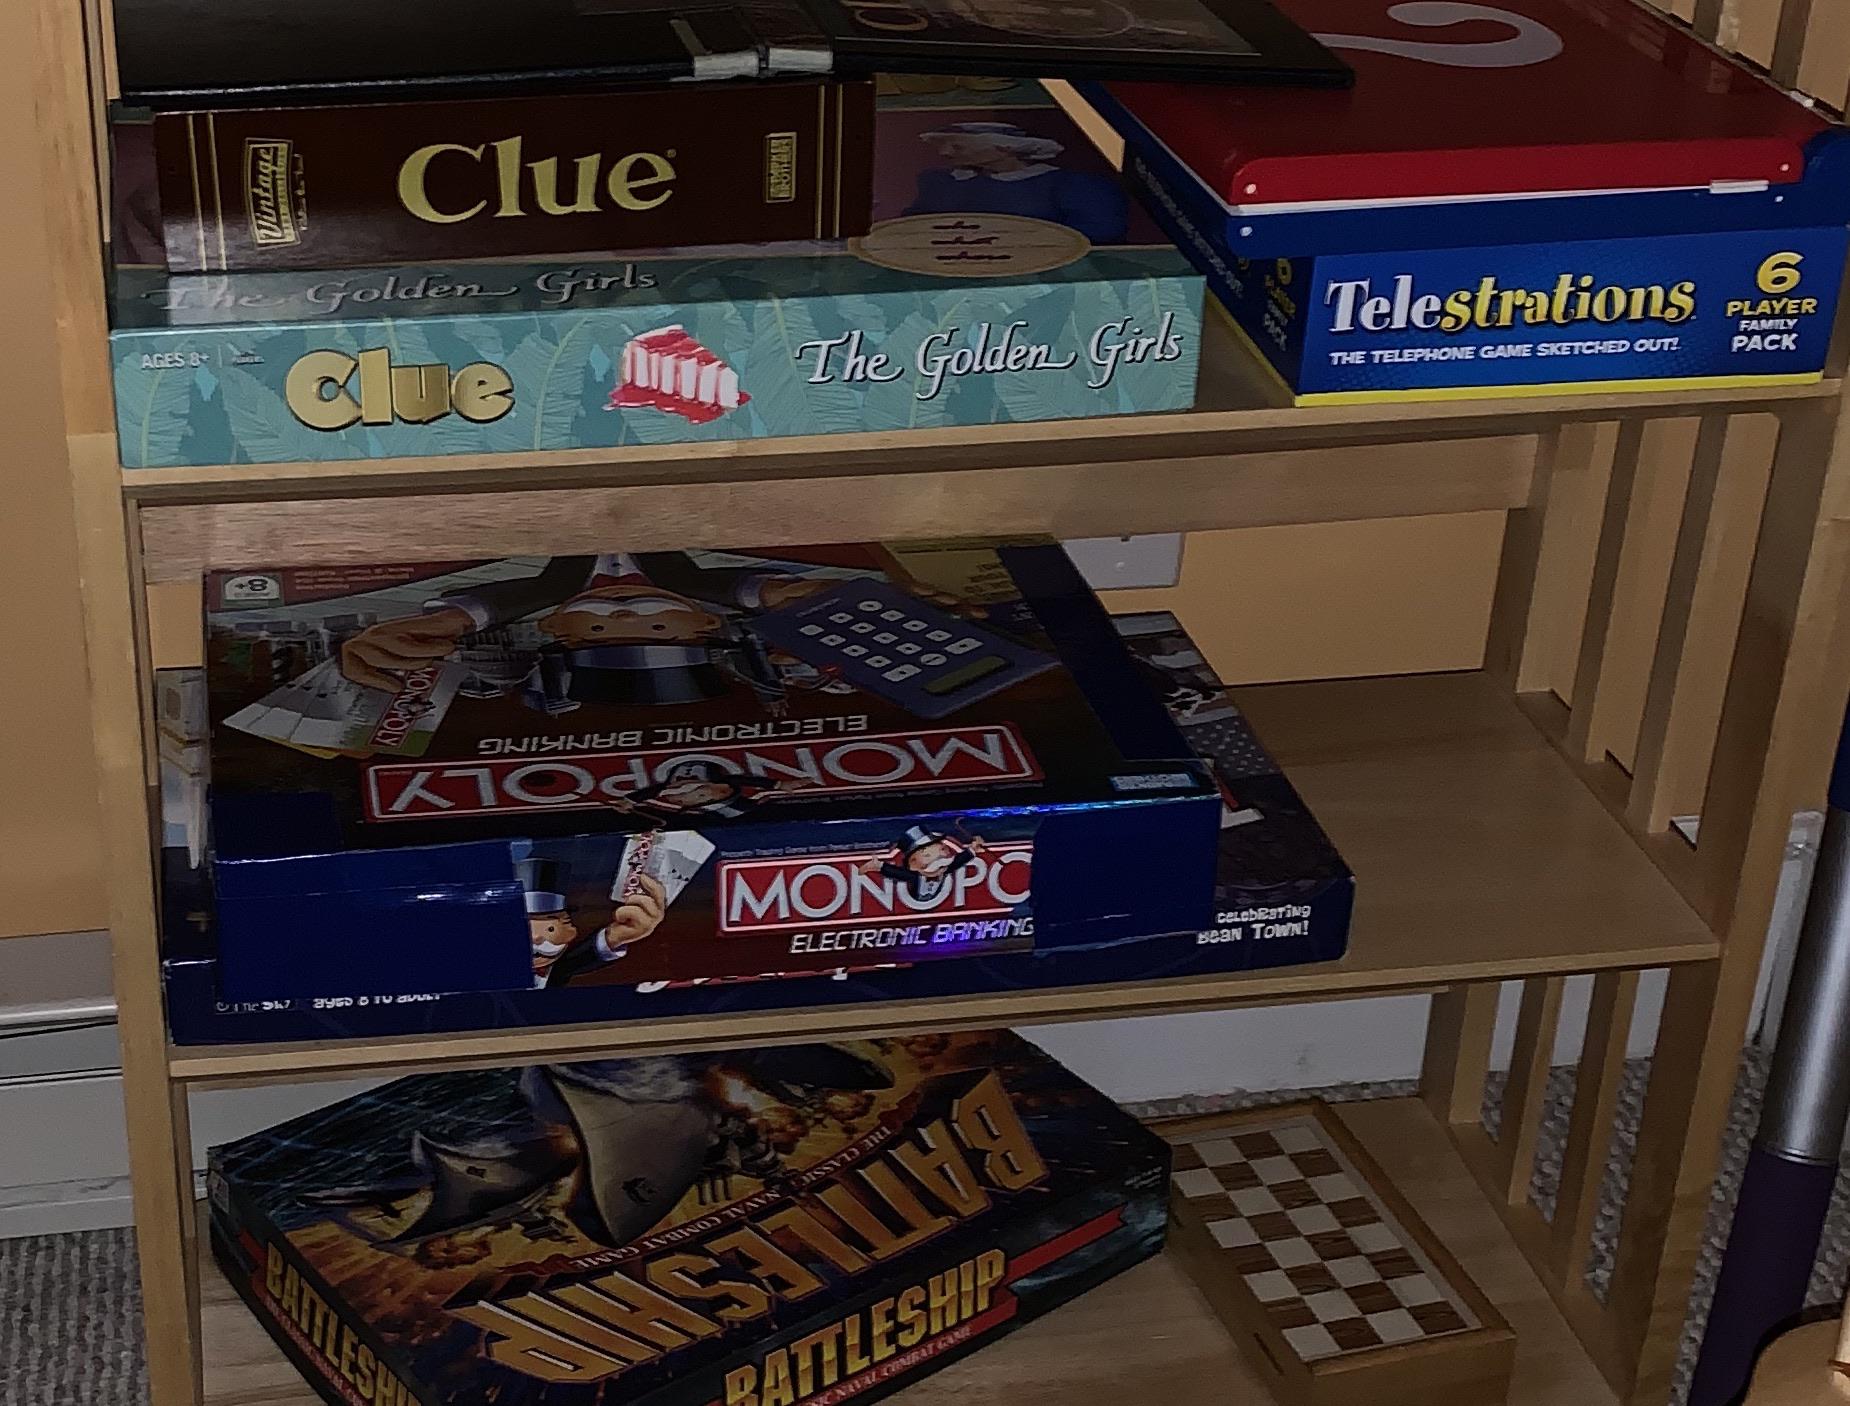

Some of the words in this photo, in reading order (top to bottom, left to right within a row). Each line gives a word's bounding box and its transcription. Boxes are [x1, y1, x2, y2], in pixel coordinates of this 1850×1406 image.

[251, 146, 283, 240] Vintage
[397, 136, 676, 223] Clue
[306, 272, 517, 314] Golden
[536, 263, 658, 302] Girls
[1757, 251, 1804, 293] 6
[1324, 273, 1695, 332] Telestrations
[1726, 298, 1817, 317] PLAYER
[1731, 333, 1798, 352] PACK
[1739, 319, 1798, 331] FAMILY
[141, 353, 185, 369] AGES
[794, 330, 903, 384] The
[916, 321, 1076, 400] Golden
[1087, 312, 1184, 388] Girls
[1329, 351, 1366, 365] THE
[1372, 346, 1476, 363] TELEPHONE
[1479, 343, 1532, 359] GAME
[1536, 338, 1629, 356] SKETCHED
[1633, 336, 1680, 352] OUT!
[286, 346, 515, 431] Clue
[477, 729, 645, 755] BANKING
[654, 713, 869, 744] ELECTRONIC
[789, 925, 931, 953] ELECTRONIC
[933, 917, 1035, 943] BANKING
[726, 1188, 782, 1219] NAVAL
[447, 1070, 1050, 1382] BATTLESHIP
[641, 1216, 722, 1252] COMBAT
[569, 1245, 640, 1269] GAME
[266, 1241, 422, 1406] BATTLESHI
[725, 1249, 1005, 1406] BATTLESHIP
